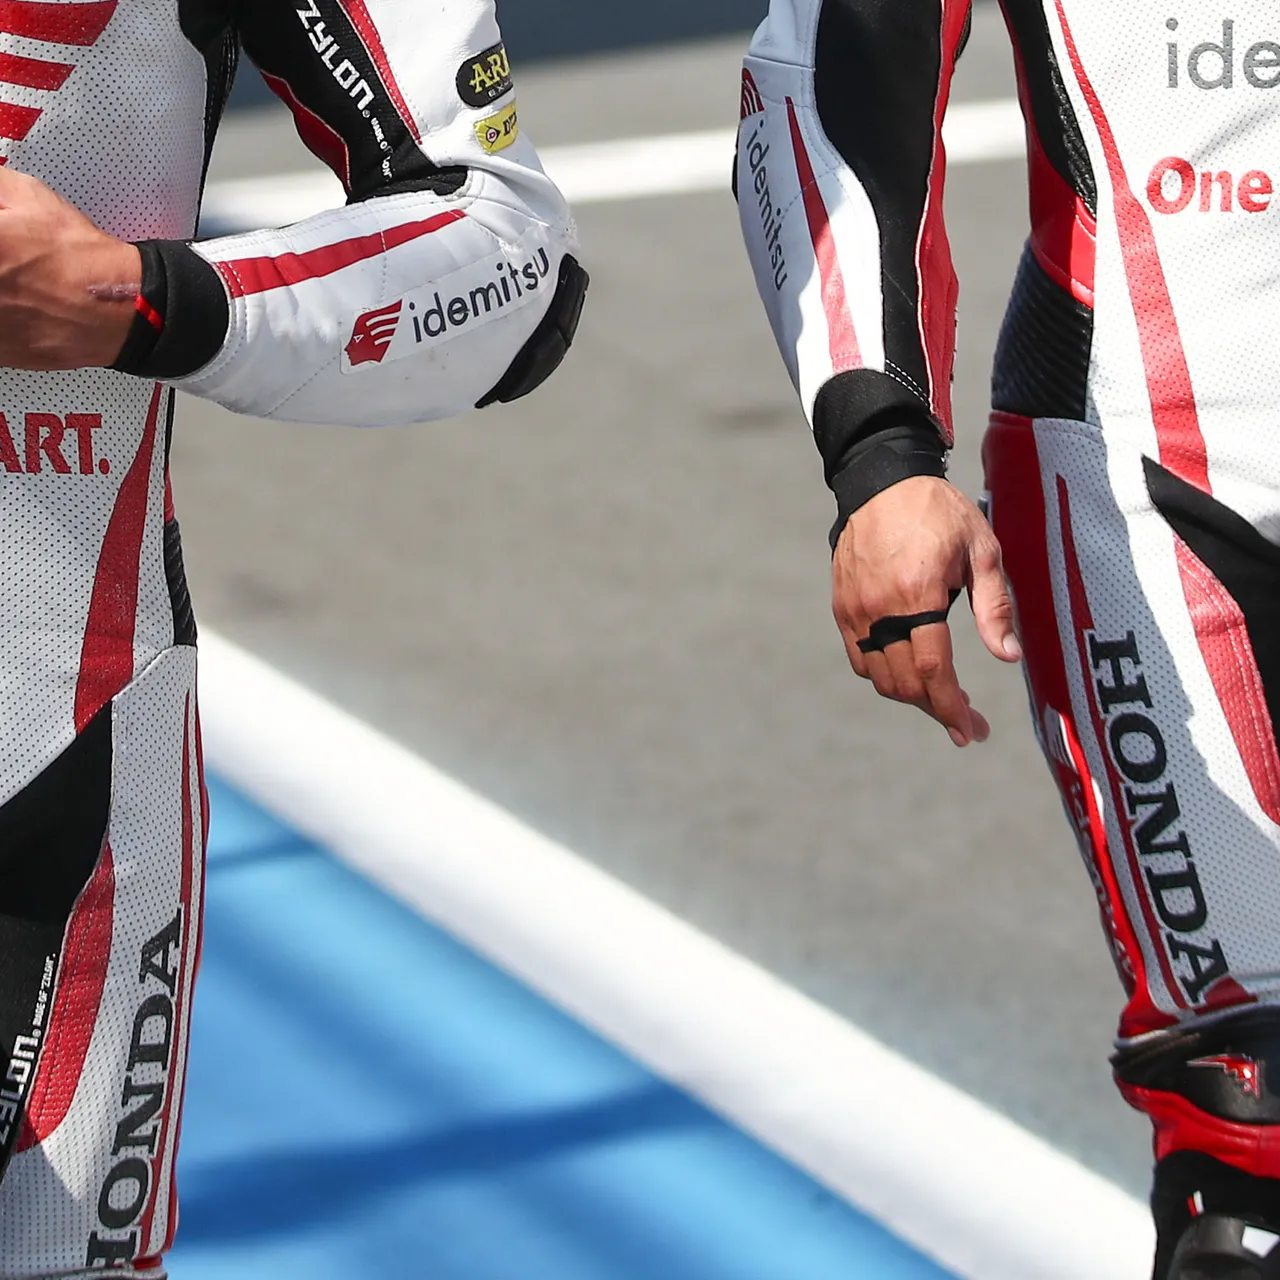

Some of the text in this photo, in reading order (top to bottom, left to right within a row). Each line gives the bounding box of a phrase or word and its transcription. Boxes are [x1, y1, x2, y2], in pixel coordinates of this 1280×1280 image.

[745, 119, 788, 292] idemitsu
[1145, 156, 1273, 214] One
[408, 246, 549, 343] idemitsu
[1088, 630, 1230, 1004] HONDA
[86, 906, 182, 1268] HONDA
